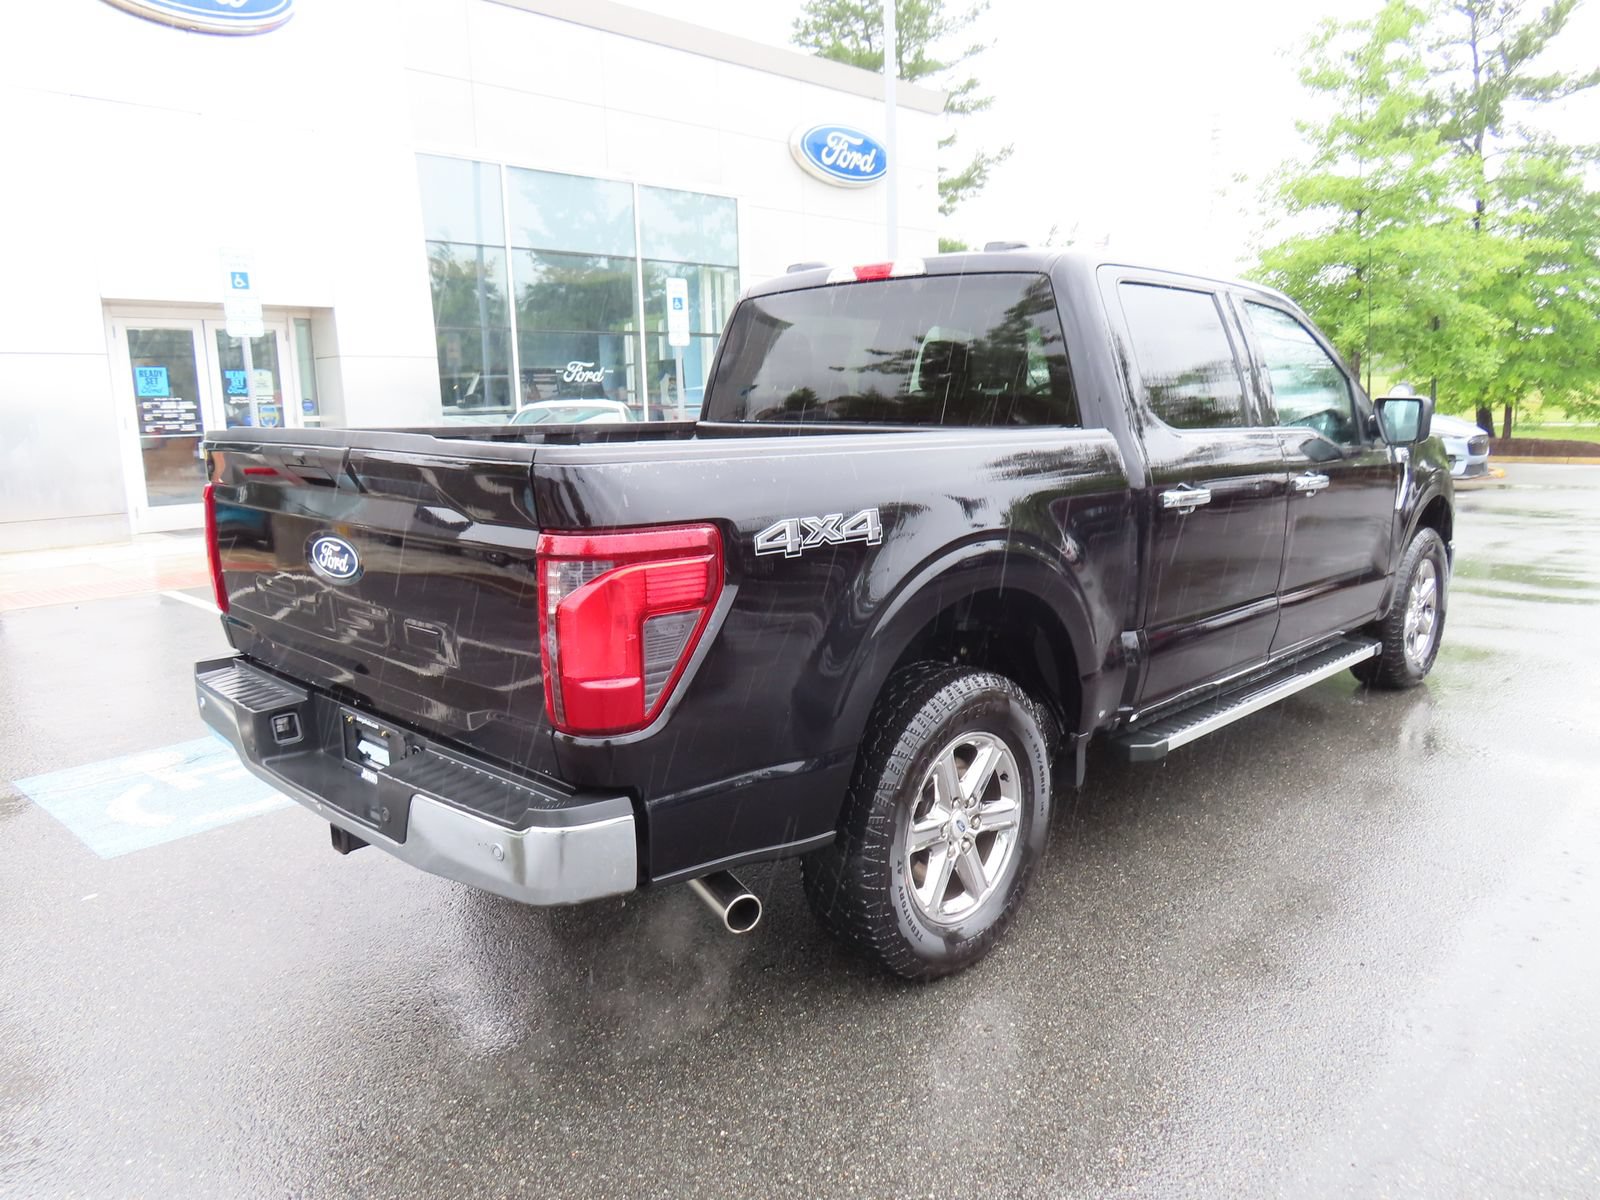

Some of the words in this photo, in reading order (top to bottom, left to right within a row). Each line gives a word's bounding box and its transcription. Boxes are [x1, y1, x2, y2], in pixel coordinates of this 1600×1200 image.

[821, 131, 877, 173] Ford
[138, 369, 163, 378] READY
[145, 377, 159, 385] SET
[562, 360, 606, 383] Ford
[319, 541, 349, 573] Ford
[897, 858, 904, 876] AT
[897, 886, 924, 944] TERRITORY
